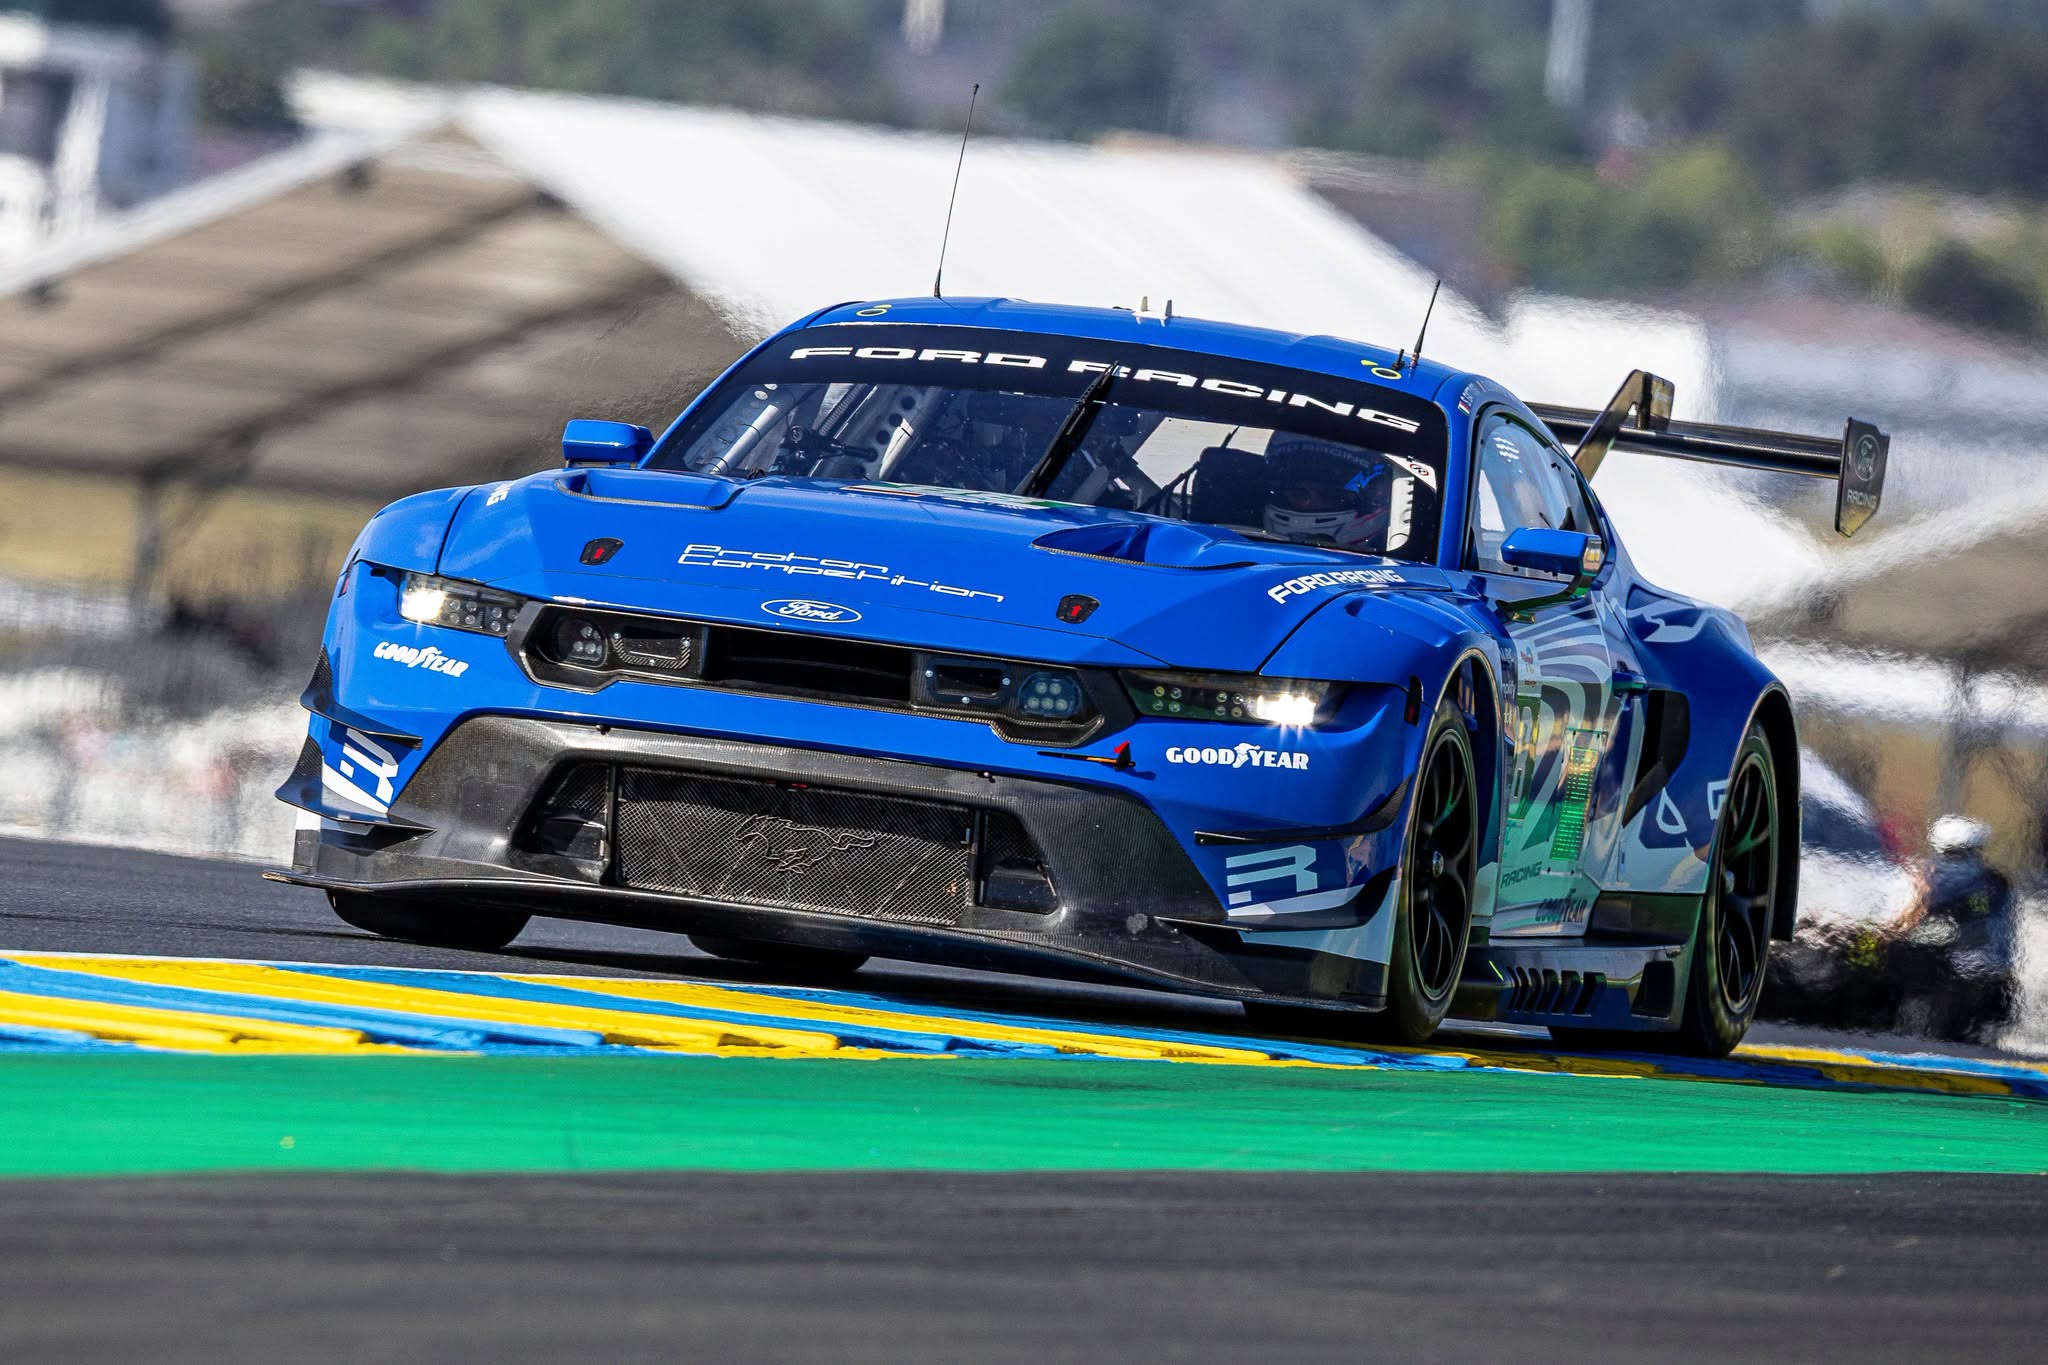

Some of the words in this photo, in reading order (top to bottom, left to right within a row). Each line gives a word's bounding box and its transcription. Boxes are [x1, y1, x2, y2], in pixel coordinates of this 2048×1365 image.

[790, 347, 1047, 368] FORD
[1067, 360, 1420, 433] RACING
[684, 543, 888, 573] Proton
[678, 553, 1004, 603] Competition
[1267, 572, 1339, 605] FORD
[1332, 569, 1407, 584] RACING
[779, 601, 844, 620] Ford
[373, 641, 469, 678] GOODYEAR
[1165, 742, 1309, 770] GOODYEAR
[1500, 861, 1542, 889] RACING
